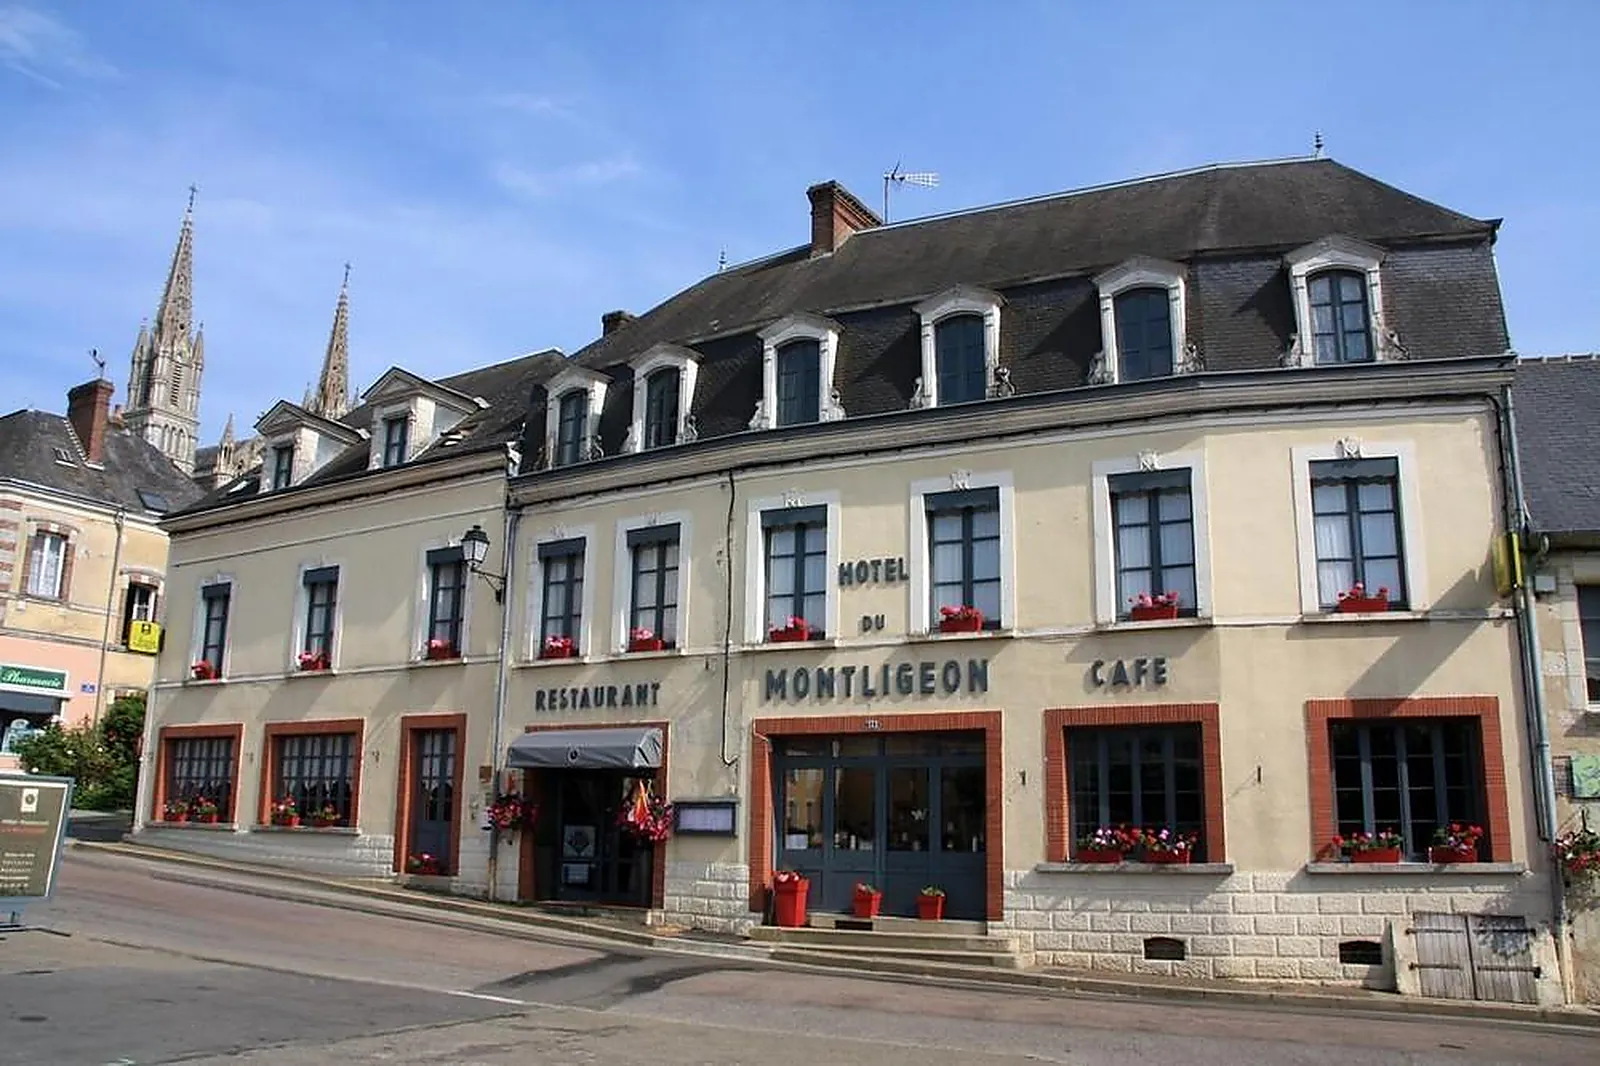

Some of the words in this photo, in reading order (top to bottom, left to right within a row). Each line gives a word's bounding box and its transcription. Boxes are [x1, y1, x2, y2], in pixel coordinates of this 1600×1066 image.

[838, 557, 910, 587] HOTEL
[861, 614, 885, 633] DU
[765, 658, 989, 700] MONTLIGEON
[1091, 657, 1167, 686] CAFE
[535, 682, 661, 712] RESTAURANT
